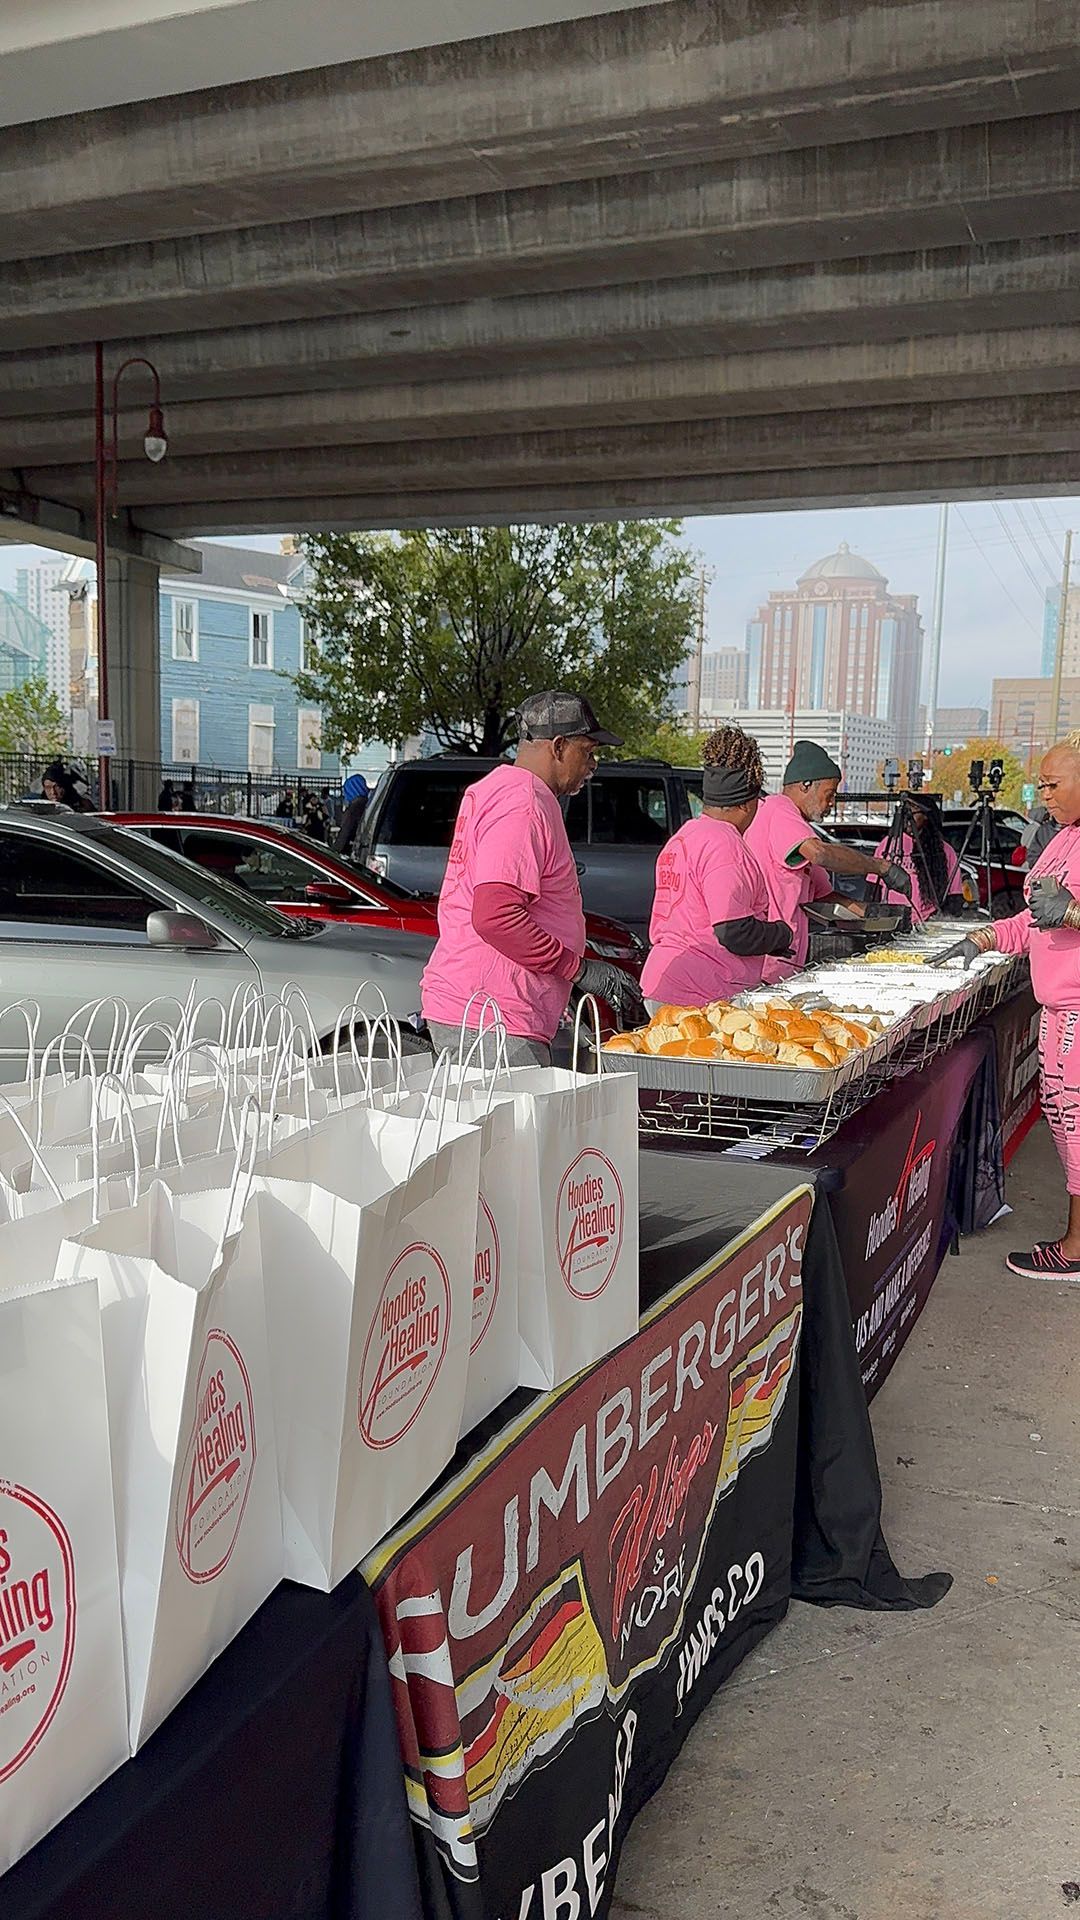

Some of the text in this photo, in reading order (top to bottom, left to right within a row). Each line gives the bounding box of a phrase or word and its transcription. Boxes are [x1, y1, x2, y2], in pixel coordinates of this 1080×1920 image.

[567, 1173, 604, 1212] Hoodies
[578, 1201, 616, 1241] Healing
[379, 1276, 427, 1340] Hoodies
[388, 1304, 440, 1371] Healing
[378, 1361, 434, 1407] FOUNDATION
[197, 1401, 247, 1488] Healing
[653, 1548, 665, 1575] &
[0, 1569, 54, 1648] ling
[1, 1651, 51, 1695] ATION
